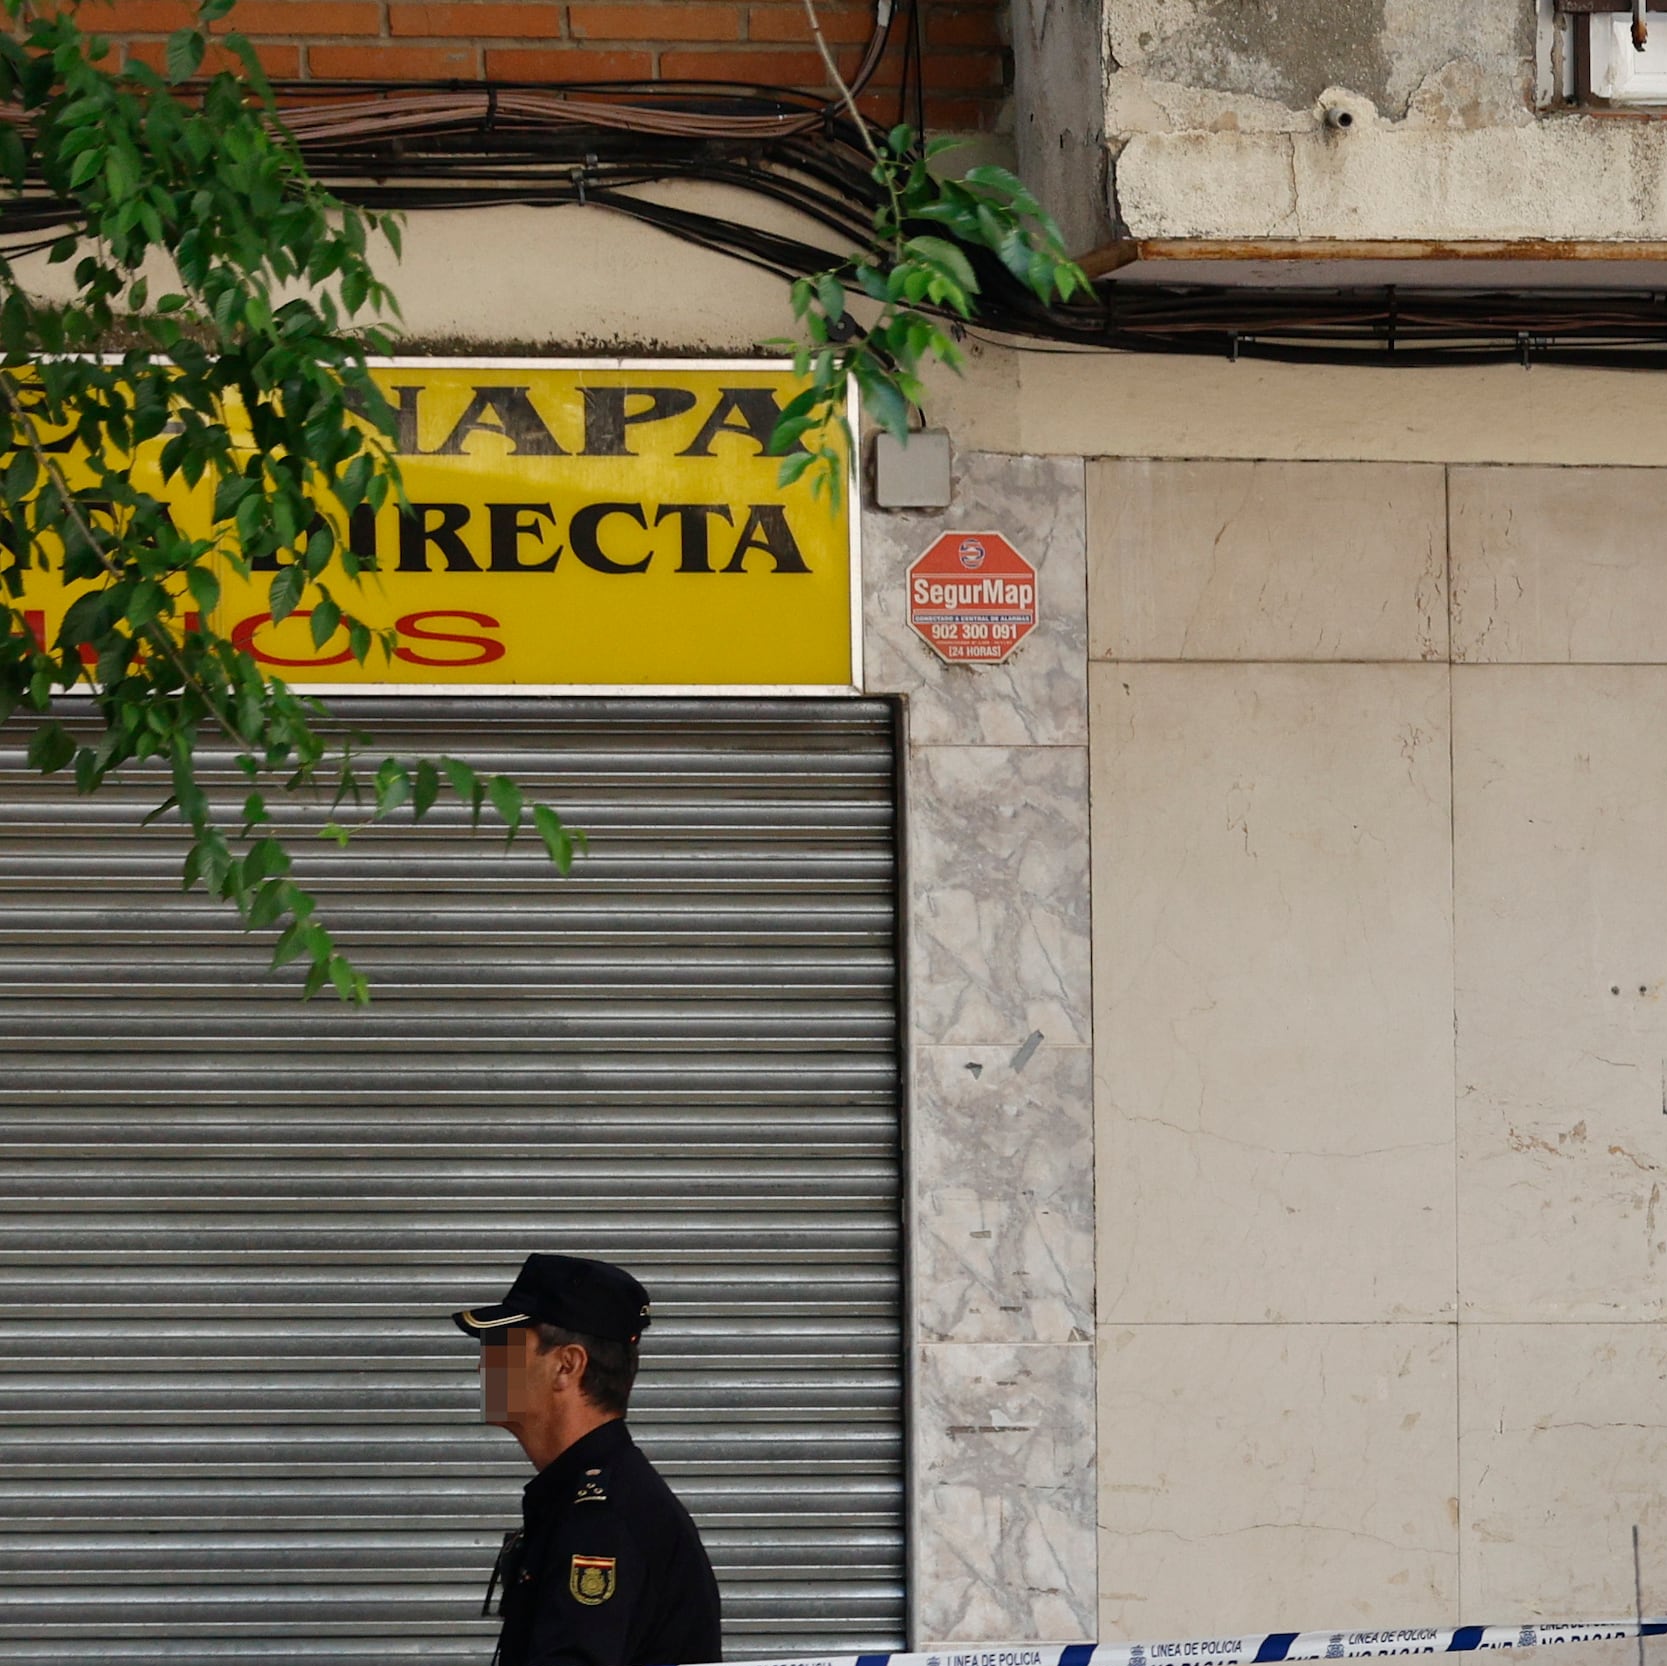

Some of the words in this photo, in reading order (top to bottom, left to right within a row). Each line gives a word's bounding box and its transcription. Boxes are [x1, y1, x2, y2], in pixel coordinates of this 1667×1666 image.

[250, 501, 814, 574] IRECTA
[913, 578, 1033, 609] SegurMap
[931, 624, 958, 639] 902
[962, 624, 988, 639] 300
[992, 624, 1017, 639] 091
[1348, 1632, 1379, 1645] LINEA
[1380, 1631, 1396, 1643] DE
[1397, 1628, 1438, 1642] POLICIA
[1151, 1643, 1182, 1658] LINEA
[1184, 1642, 1200, 1656] DE
[1200, 1640, 1243, 1655] POLICIA
[999, 1651, 1042, 1666] POLICIA
